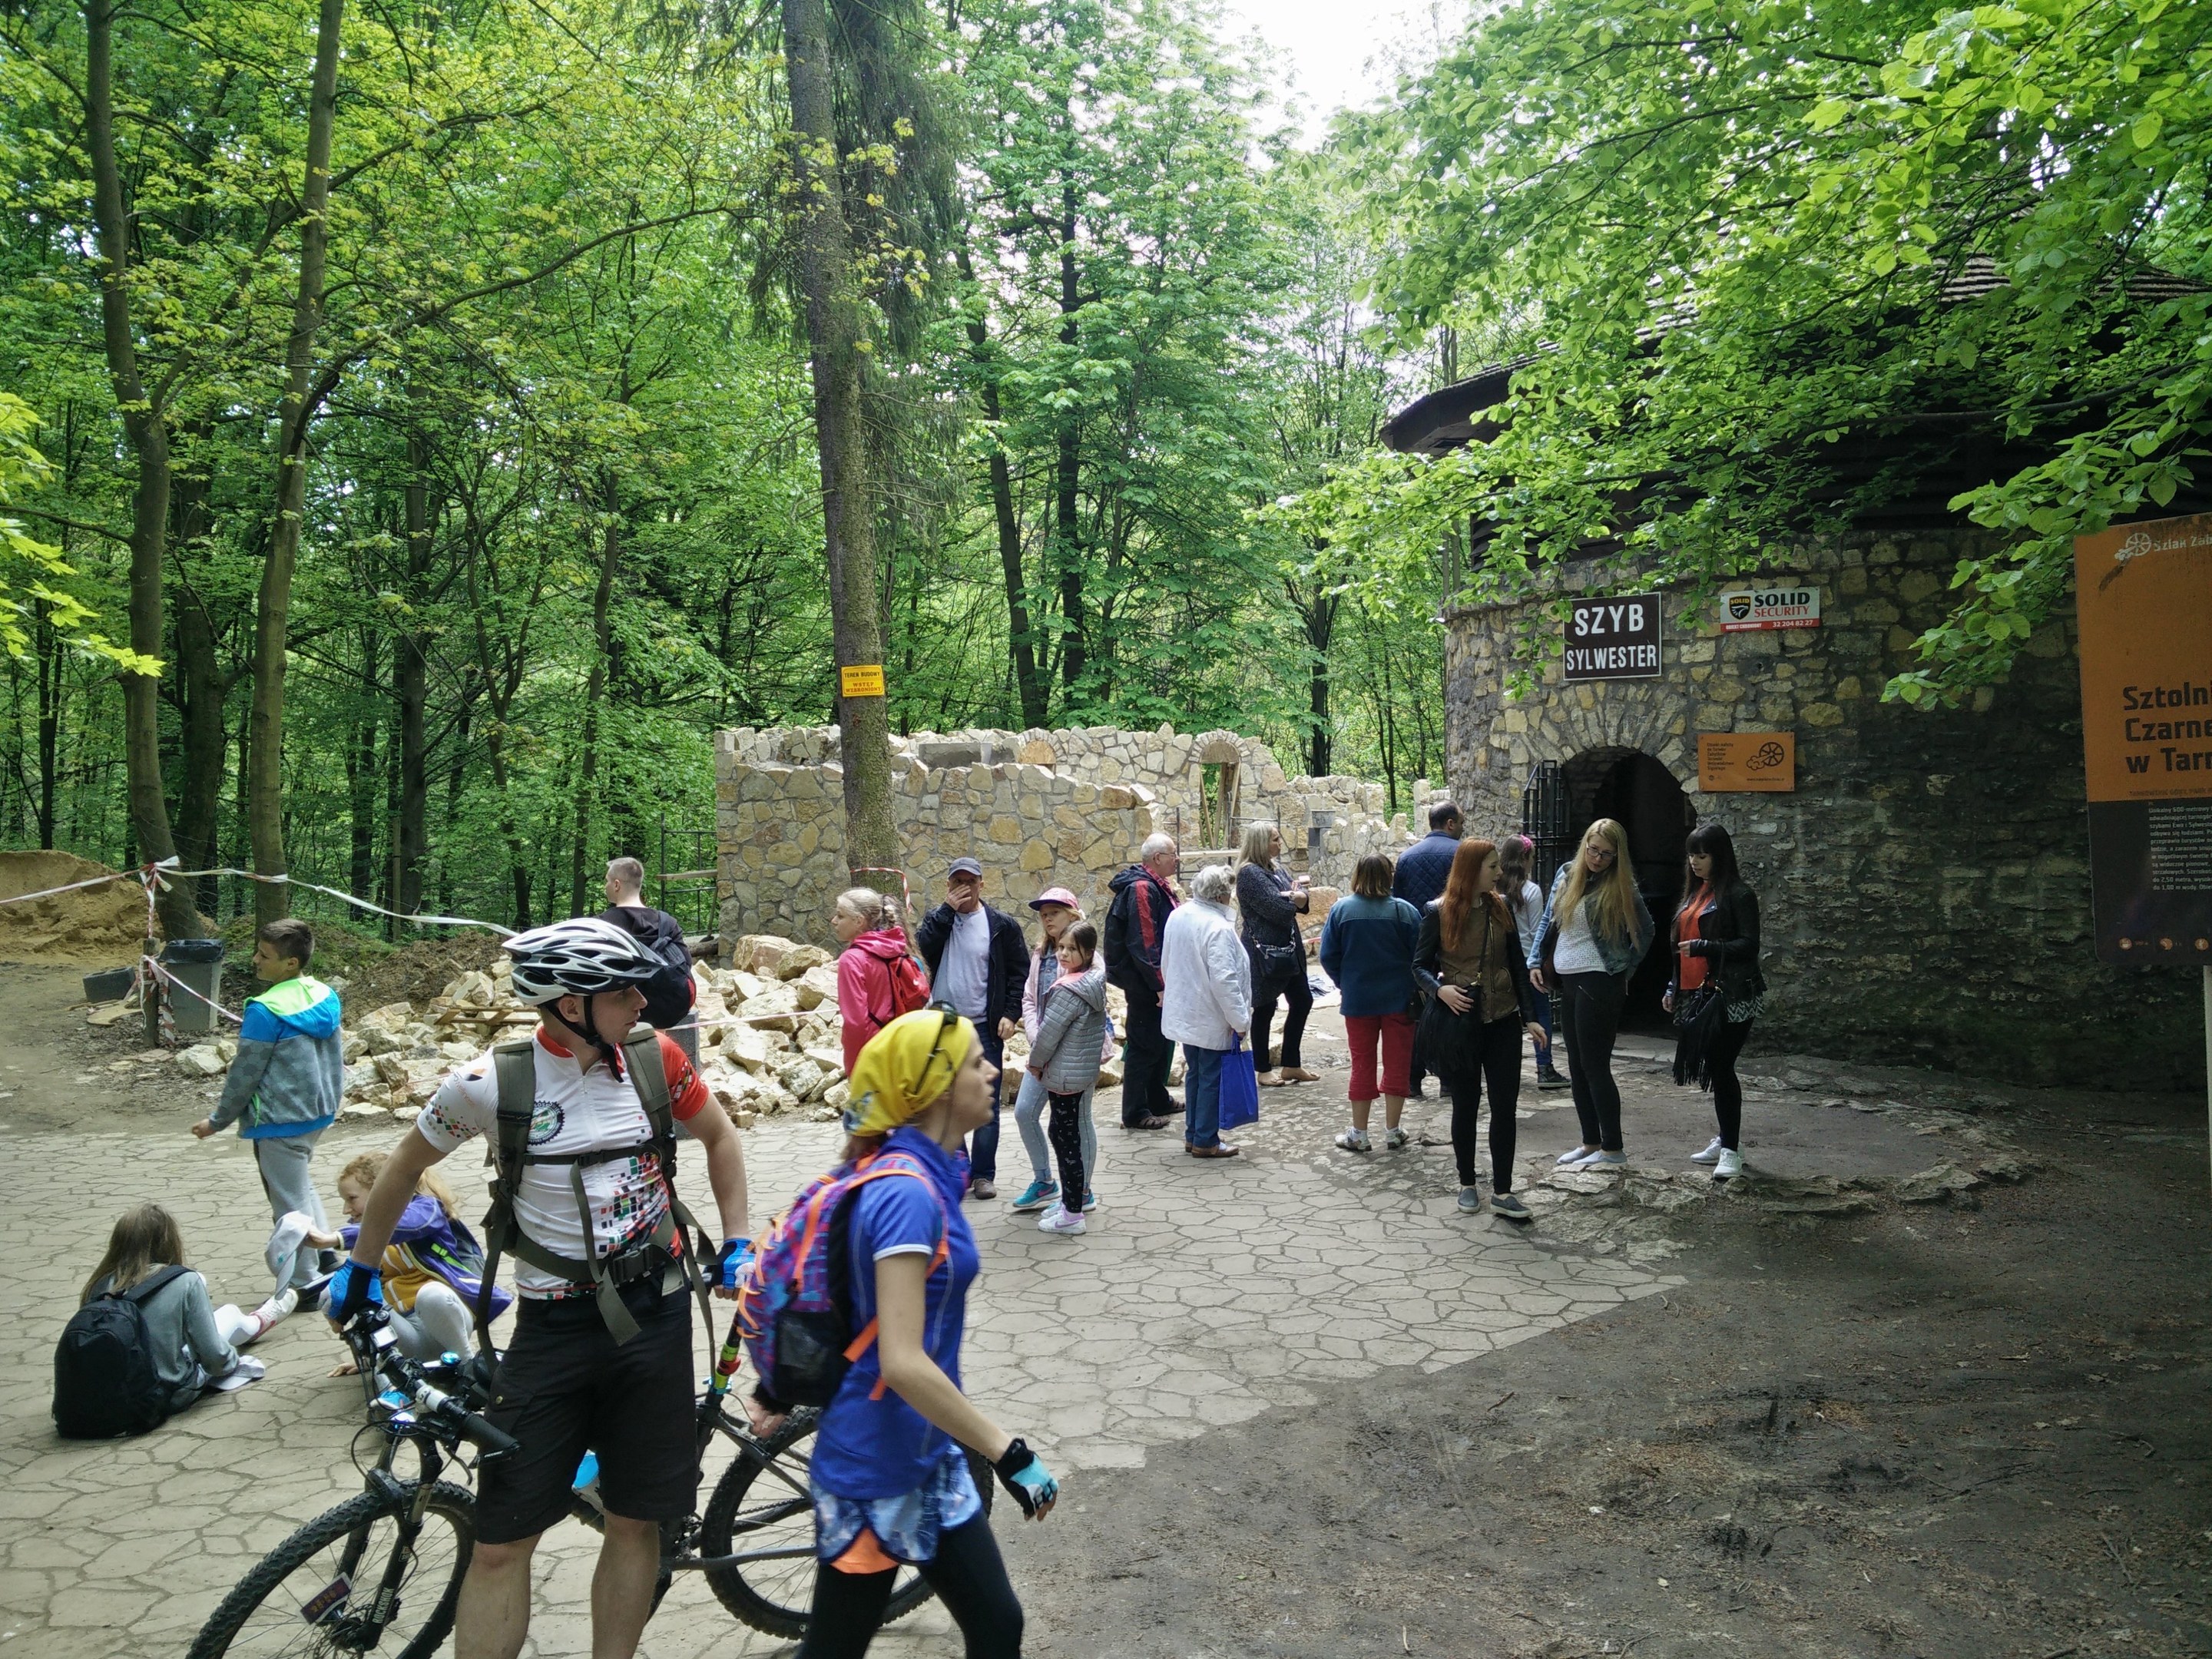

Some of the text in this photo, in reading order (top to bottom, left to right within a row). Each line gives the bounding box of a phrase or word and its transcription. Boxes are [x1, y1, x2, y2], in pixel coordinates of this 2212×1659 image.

[1754, 592, 1810, 608] SOLID
[1575, 604, 1644, 636] SZYB
[1754, 605, 1810, 618] SECURITY
[1566, 644, 1657, 671] SYLWESTER
[2126, 755, 2150, 774] w
